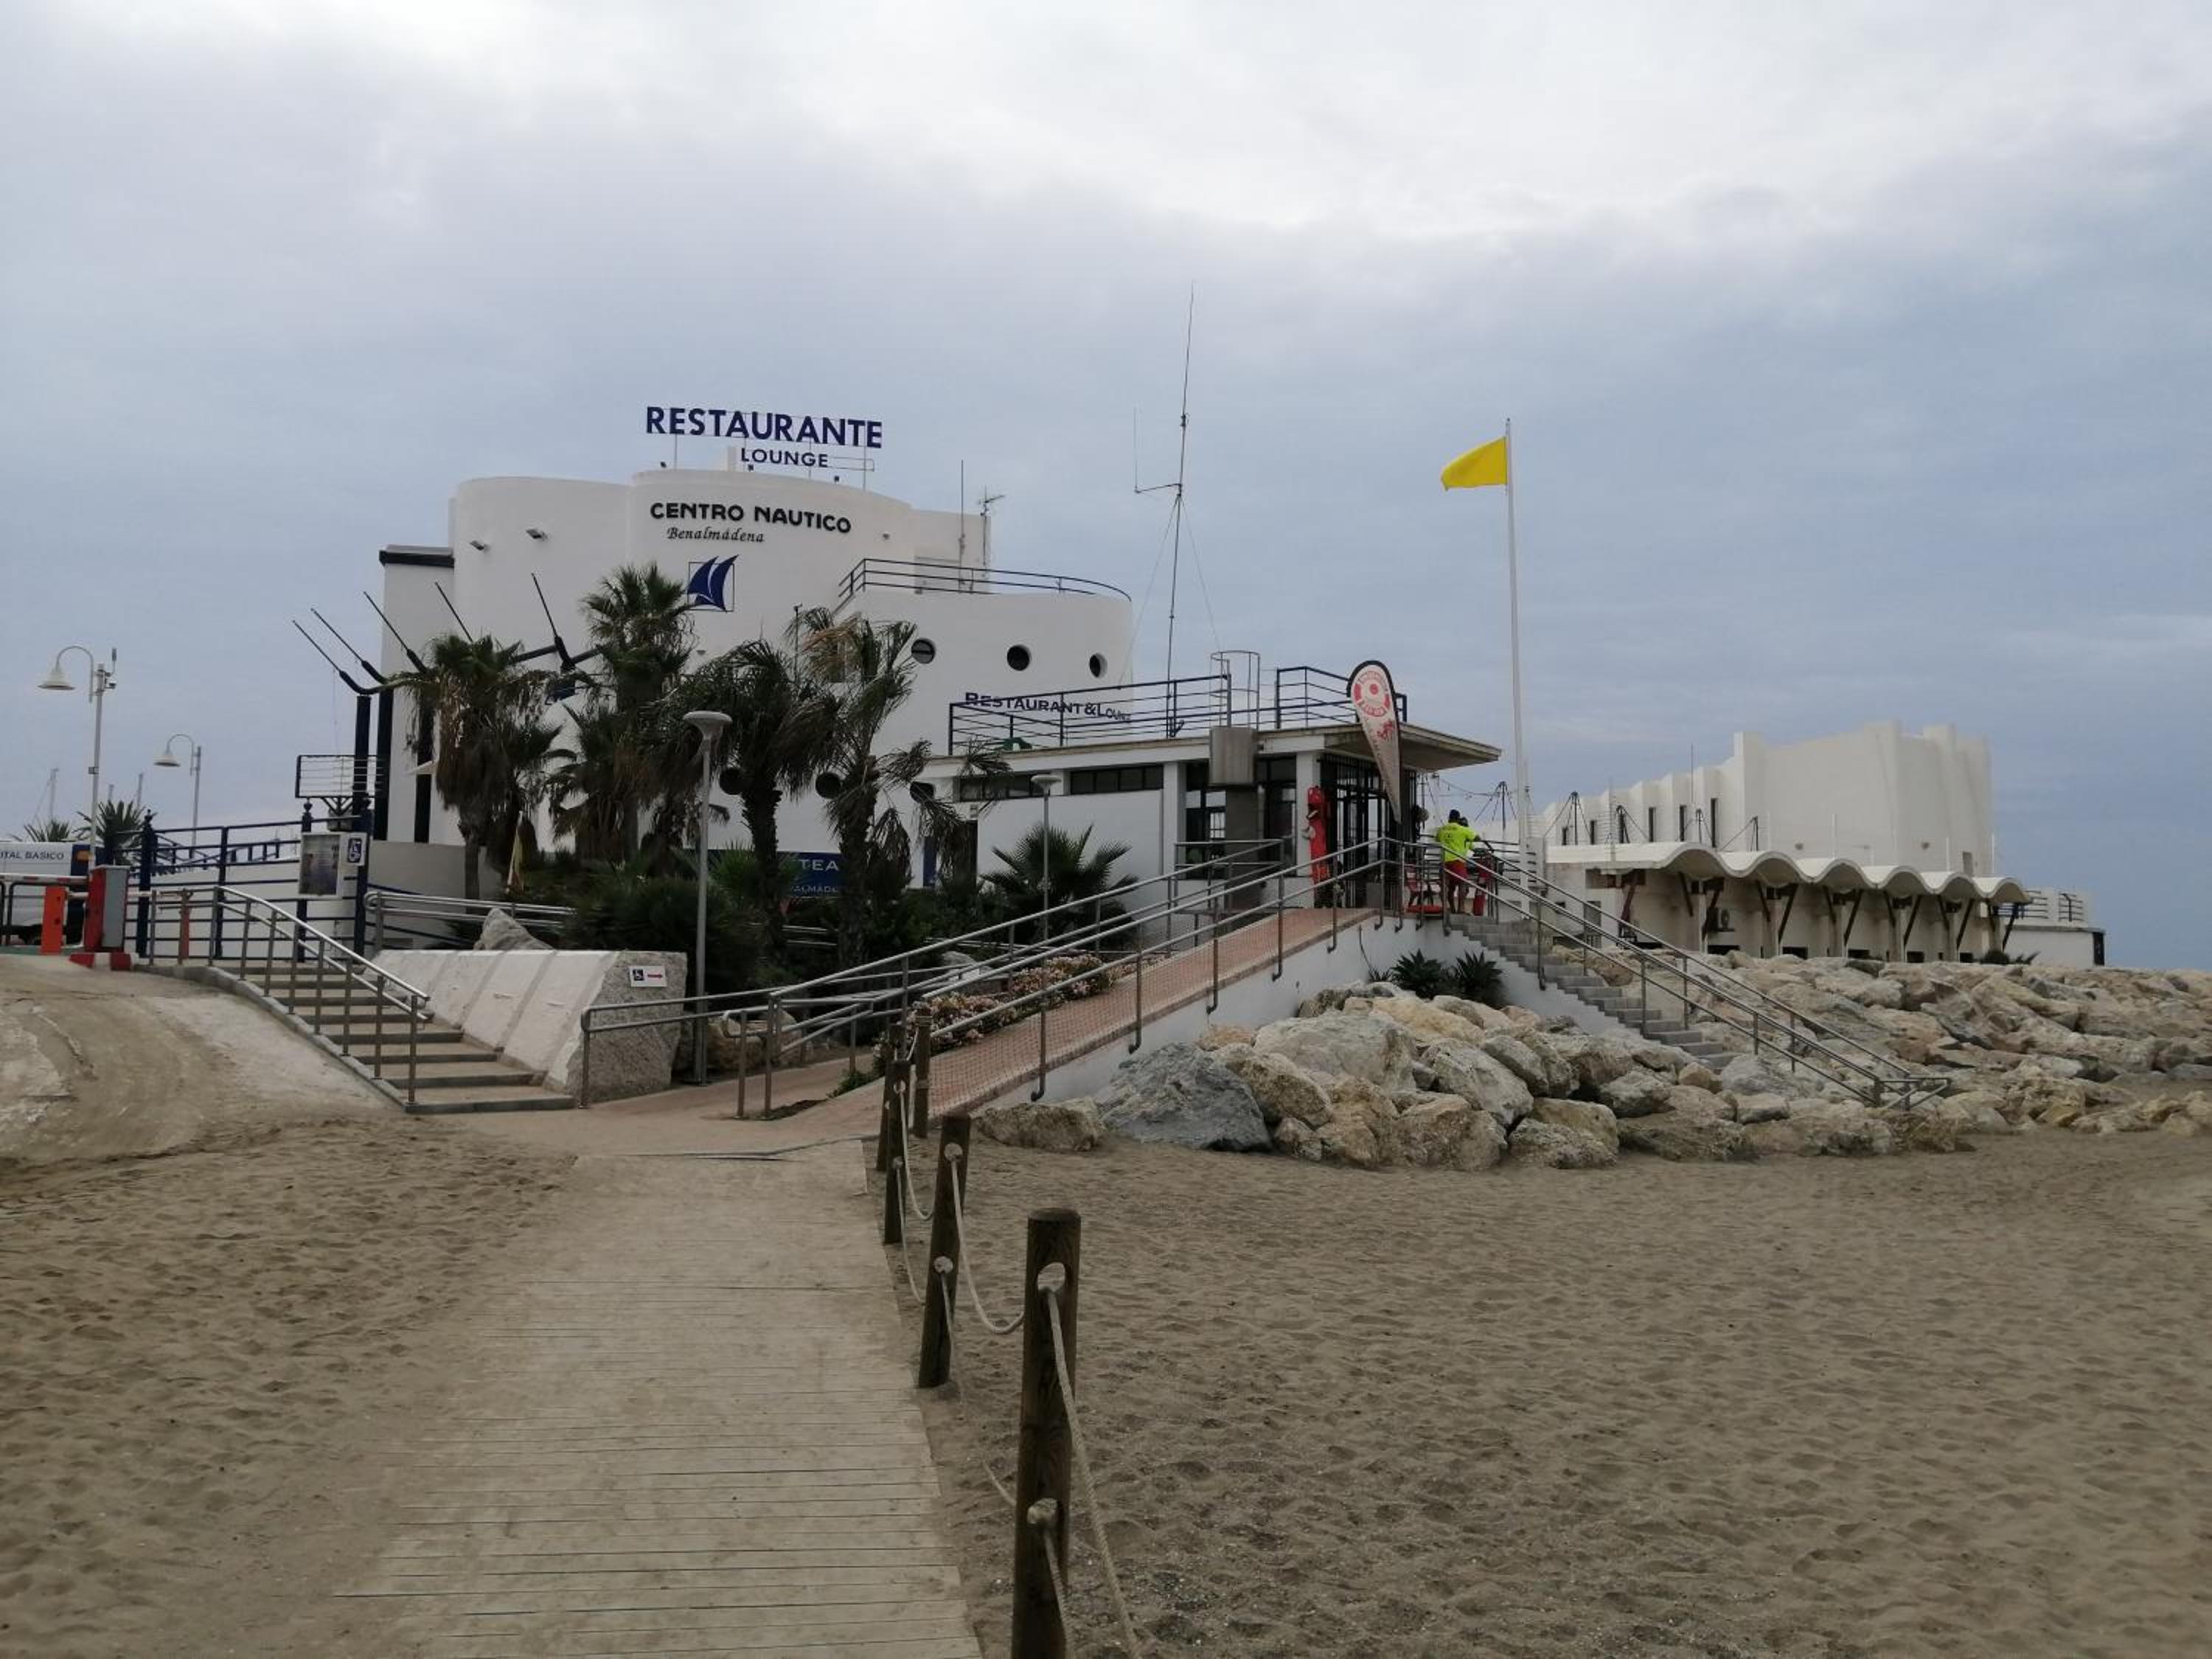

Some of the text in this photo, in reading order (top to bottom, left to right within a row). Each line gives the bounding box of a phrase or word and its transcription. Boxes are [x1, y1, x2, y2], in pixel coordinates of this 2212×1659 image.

[646, 406, 883, 448] RESTAURANTE
[740, 448, 829, 467] LOUNGE
[650, 503, 852, 533] CENTRO NAUTICO
[667, 526, 765, 543] Benalmádena
